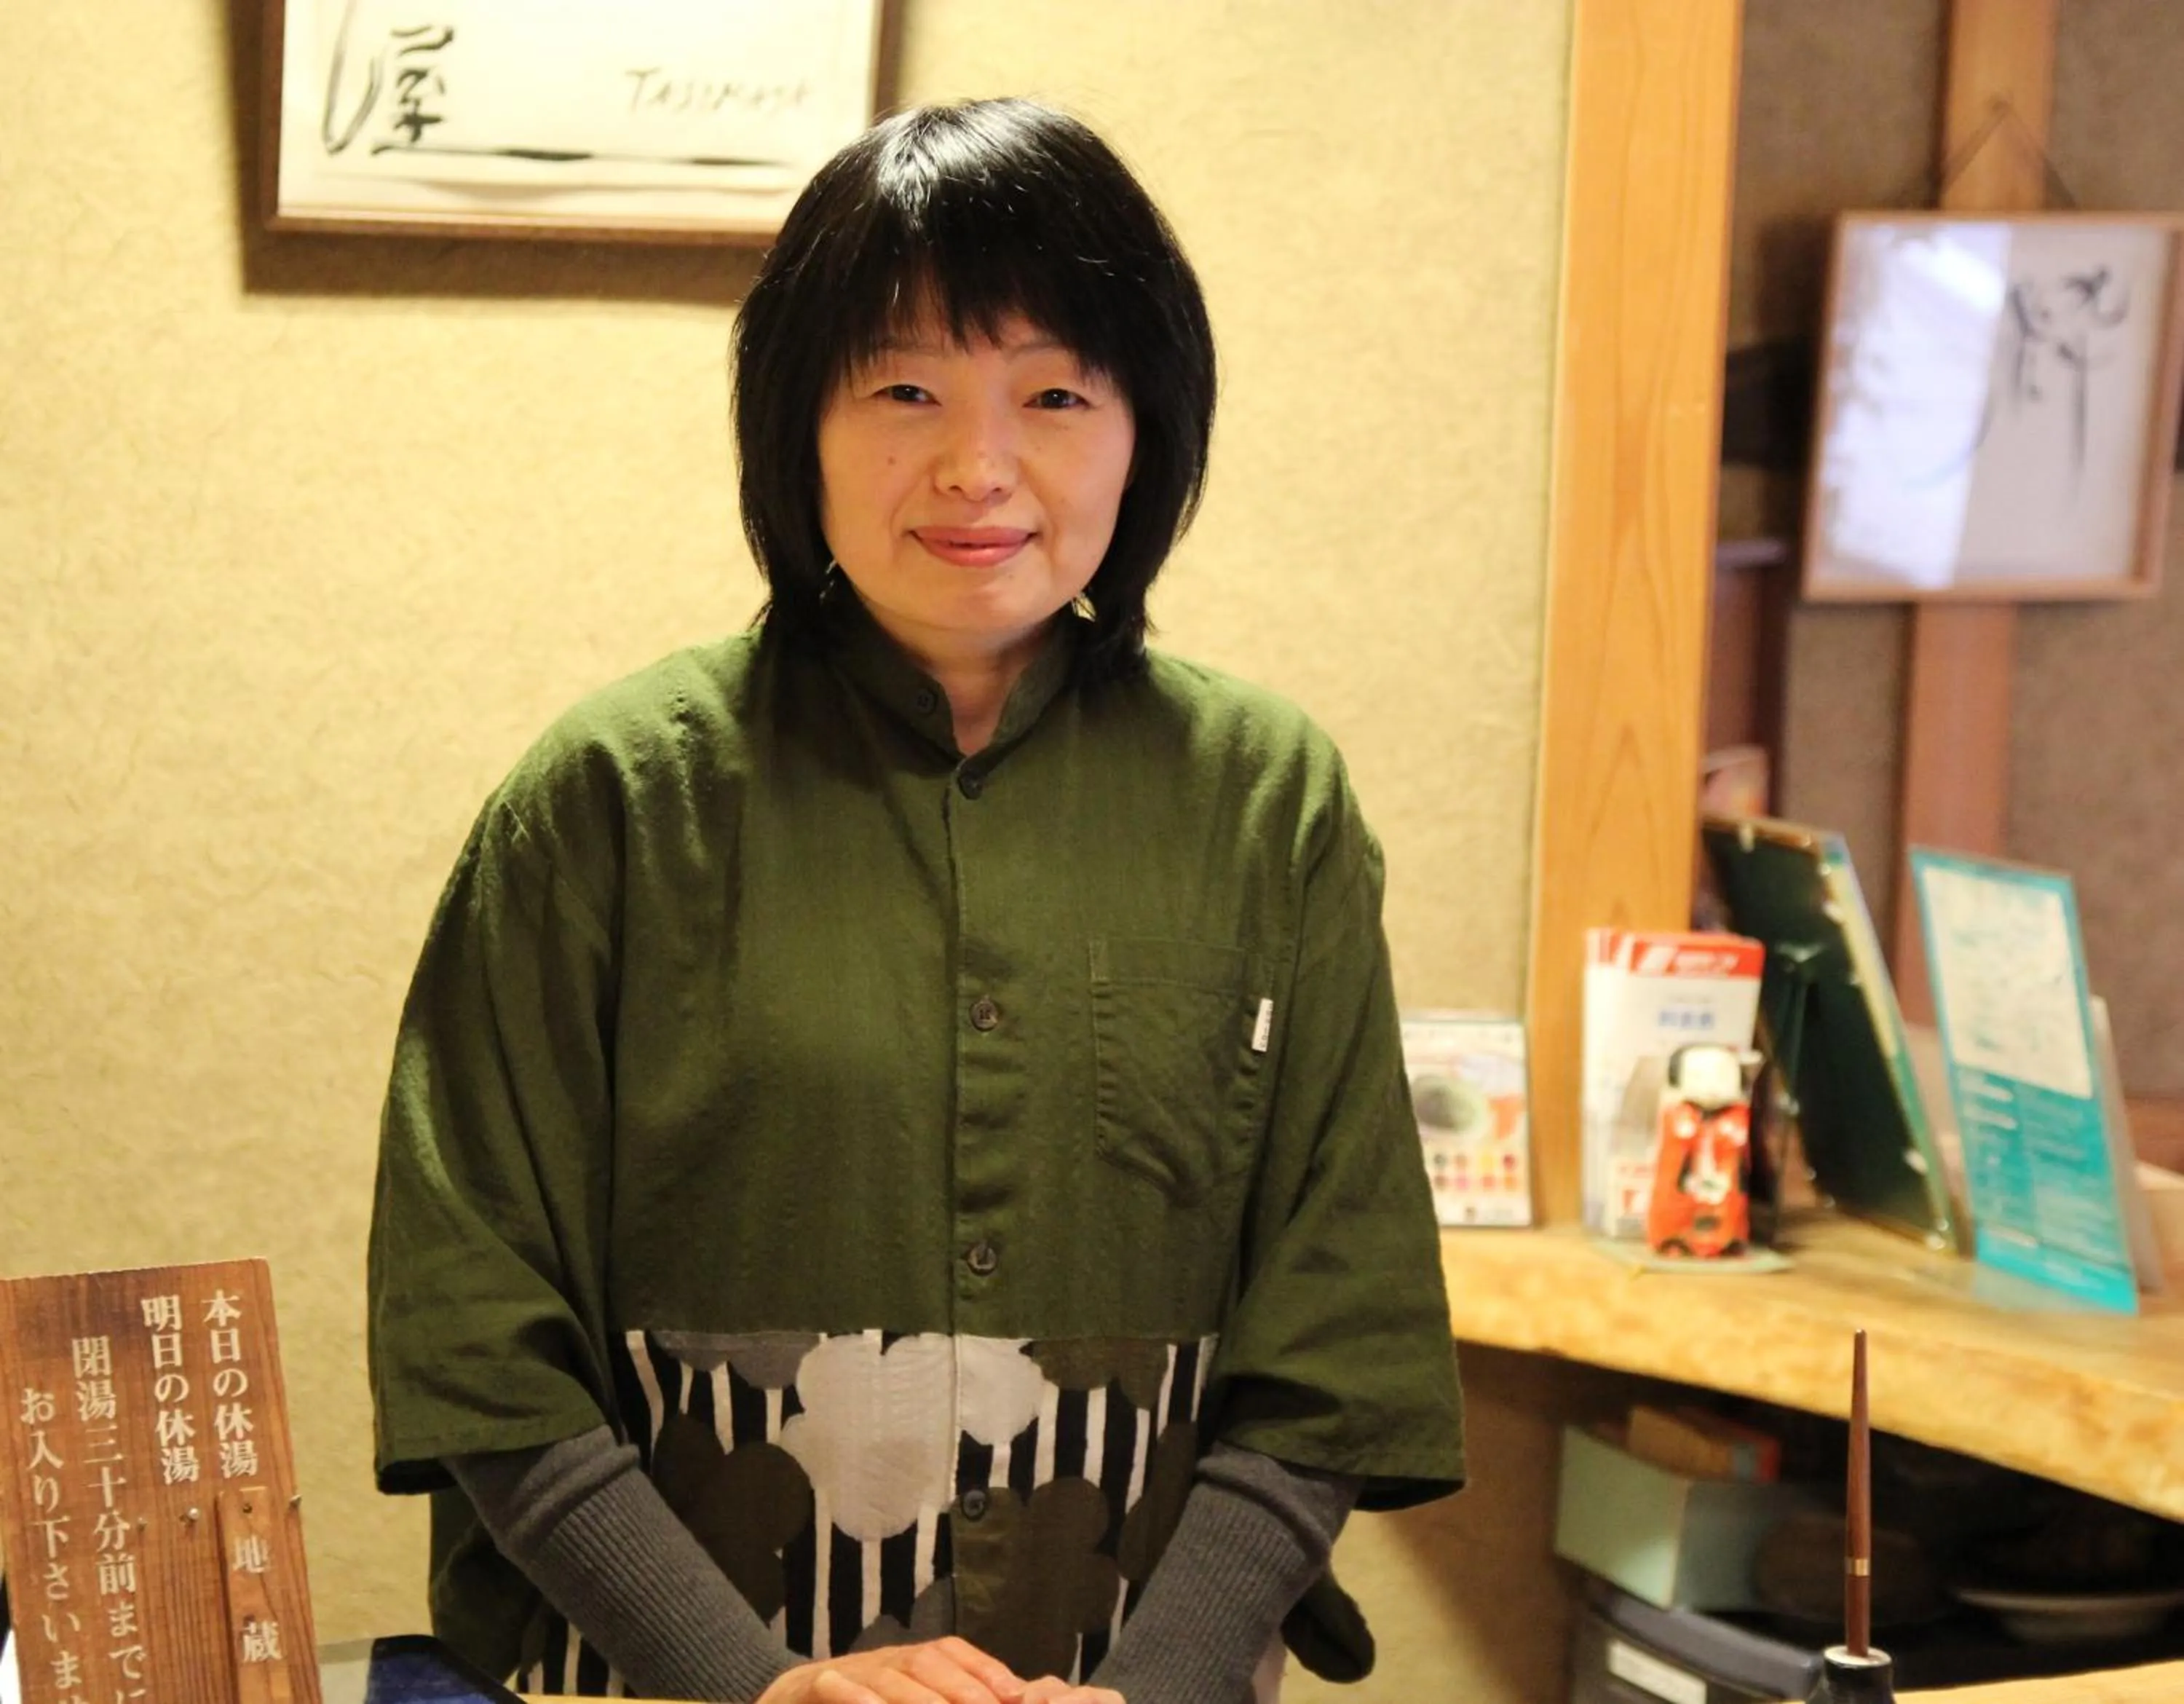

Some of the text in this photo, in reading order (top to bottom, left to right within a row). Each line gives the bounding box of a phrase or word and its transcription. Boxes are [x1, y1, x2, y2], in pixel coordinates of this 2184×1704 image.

[141, 1294, 200, 1485] 明日の休湯
[201, 1290, 258, 1479] 本日の休湯
[20, 1387, 89, 1704] お入り下さいま
[232, 1534, 284, 1663] 地蔵
